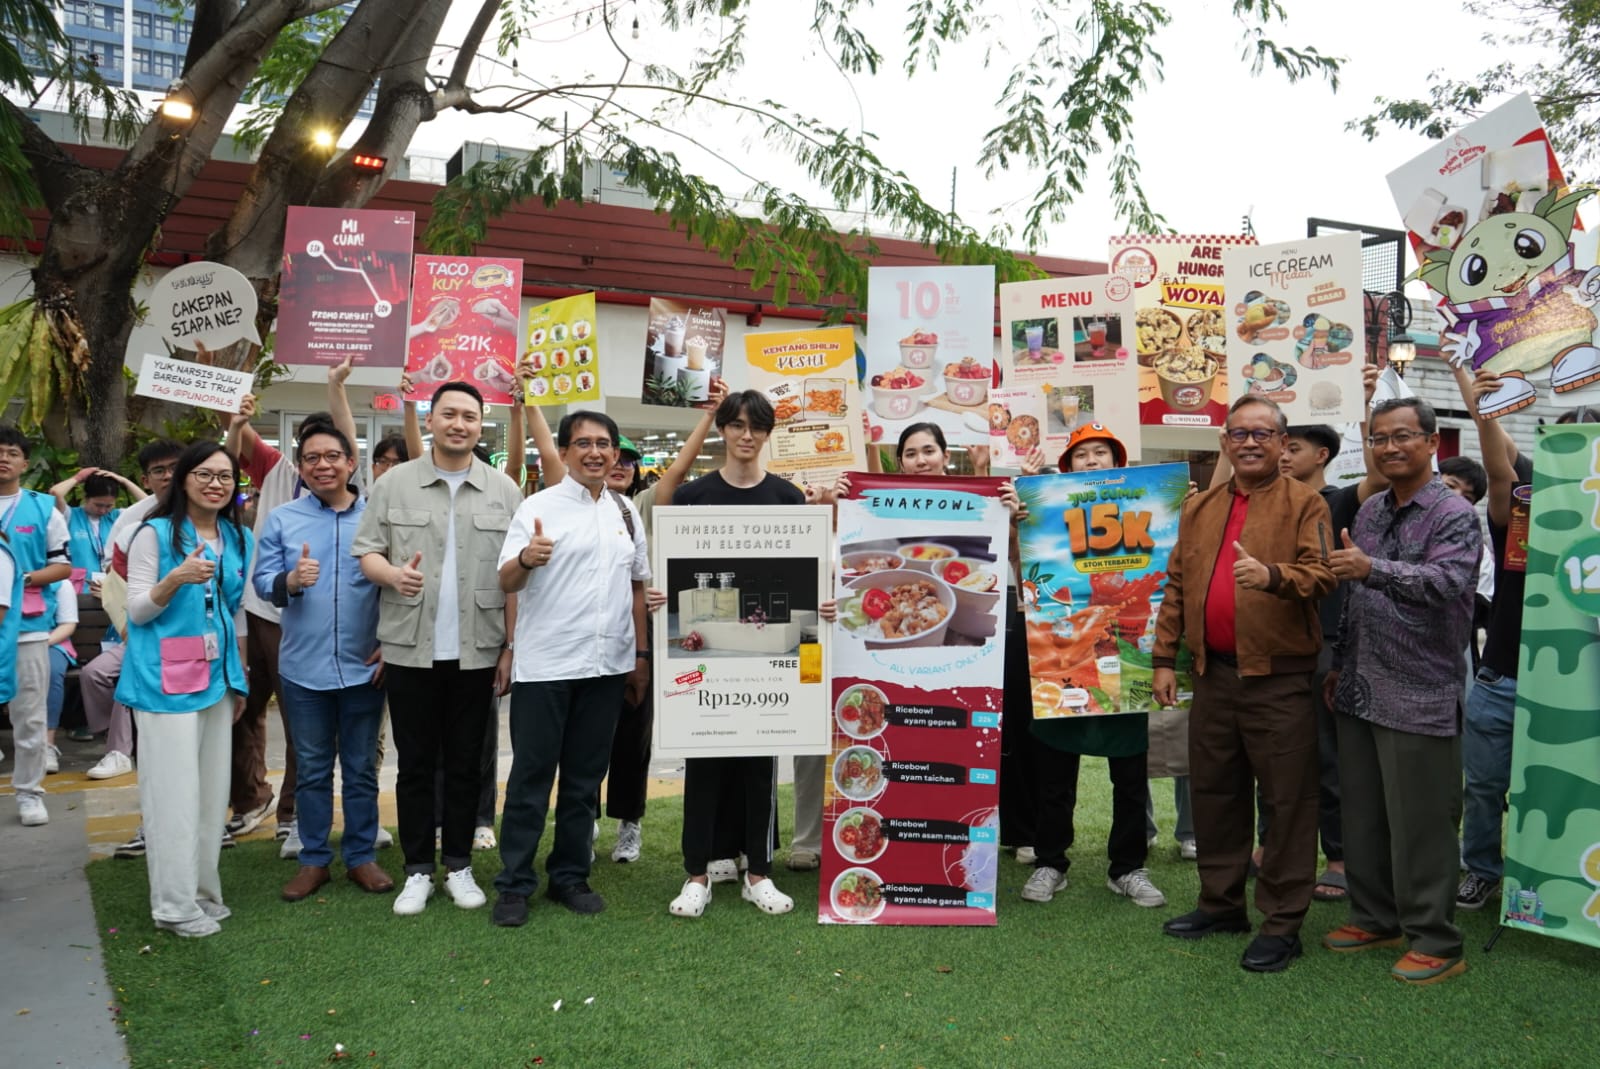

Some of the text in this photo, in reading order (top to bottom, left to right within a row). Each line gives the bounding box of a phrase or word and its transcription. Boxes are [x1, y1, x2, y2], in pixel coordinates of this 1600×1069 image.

[341, 219, 358, 233] MI
[1190, 246, 1222, 260] ARE
[427, 262, 468, 276] TACO
[1249, 254, 1333, 278] ICE CREAM
[432, 276, 464, 290] KUY
[1163, 276, 1189, 286] EAT
[1314, 281, 1335, 292] FREE
[172, 290, 233, 318] CAKEPAN
[896, 280, 940, 320] 10
[1040, 291, 1093, 308] MENU
[312, 311, 338, 320] PROMO
[171, 308, 243, 337] SIAPA NE?
[692, 318, 721, 327] SUMMER
[457, 335, 492, 351] 21K
[763, 343, 840, 355] KENTANG SHILIN
[154, 360, 242, 385] YUK NARSIS DULU
[153, 371, 238, 394] BARENG SI TRUK
[151, 384, 233, 407] TAG @PUNOPALS
[872, 497, 976, 511] ENAKPOWL
[675, 524, 813, 534] IMMERSE YOURSELF
[1062, 503, 1156, 555] 15K
[696, 540, 792, 550] IN ELEGANCE
[1082, 560, 1102, 569] STOK
[1103, 558, 1142, 567] TERBATAS!
[889, 663, 905, 674] ALL
[909, 664, 951, 675] VARIANT
[955, 653, 980, 669] ONLY
[678, 672, 700, 683] LIMITED
[698, 689, 789, 709] Rp129.999
[895, 706, 933, 714] Ricebowl
[927, 718, 957, 727] geprek
[892, 762, 929, 771] Ricebowl
[924, 774, 955, 783] taichan
[890, 820, 927, 828] Ricebowl
[944, 833, 968, 841] manis
[885, 885, 923, 893] Ricebowl
[917, 896, 937, 904] cabe
[938, 898, 966, 906] garam
